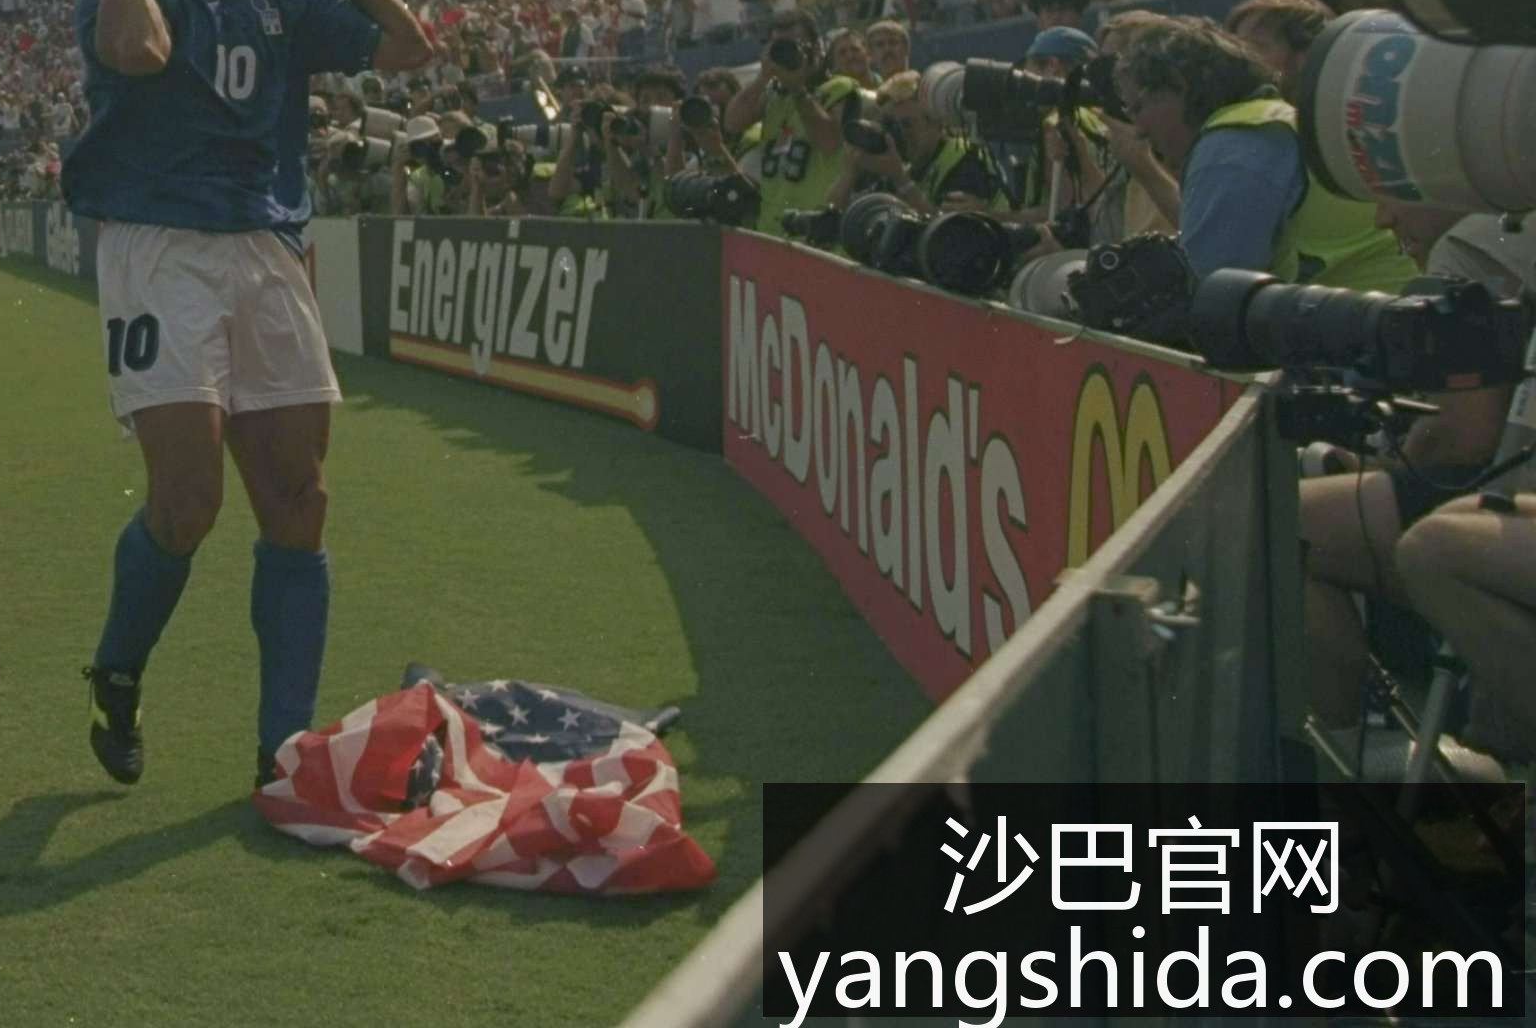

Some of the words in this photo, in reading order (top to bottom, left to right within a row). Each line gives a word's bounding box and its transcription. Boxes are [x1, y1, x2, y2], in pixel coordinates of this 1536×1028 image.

[215, 43, 257, 101] 10
[107, 312, 160, 377] 10
[389, 220, 609, 376] Energizer
[727, 274, 1035, 662] McDonald's
